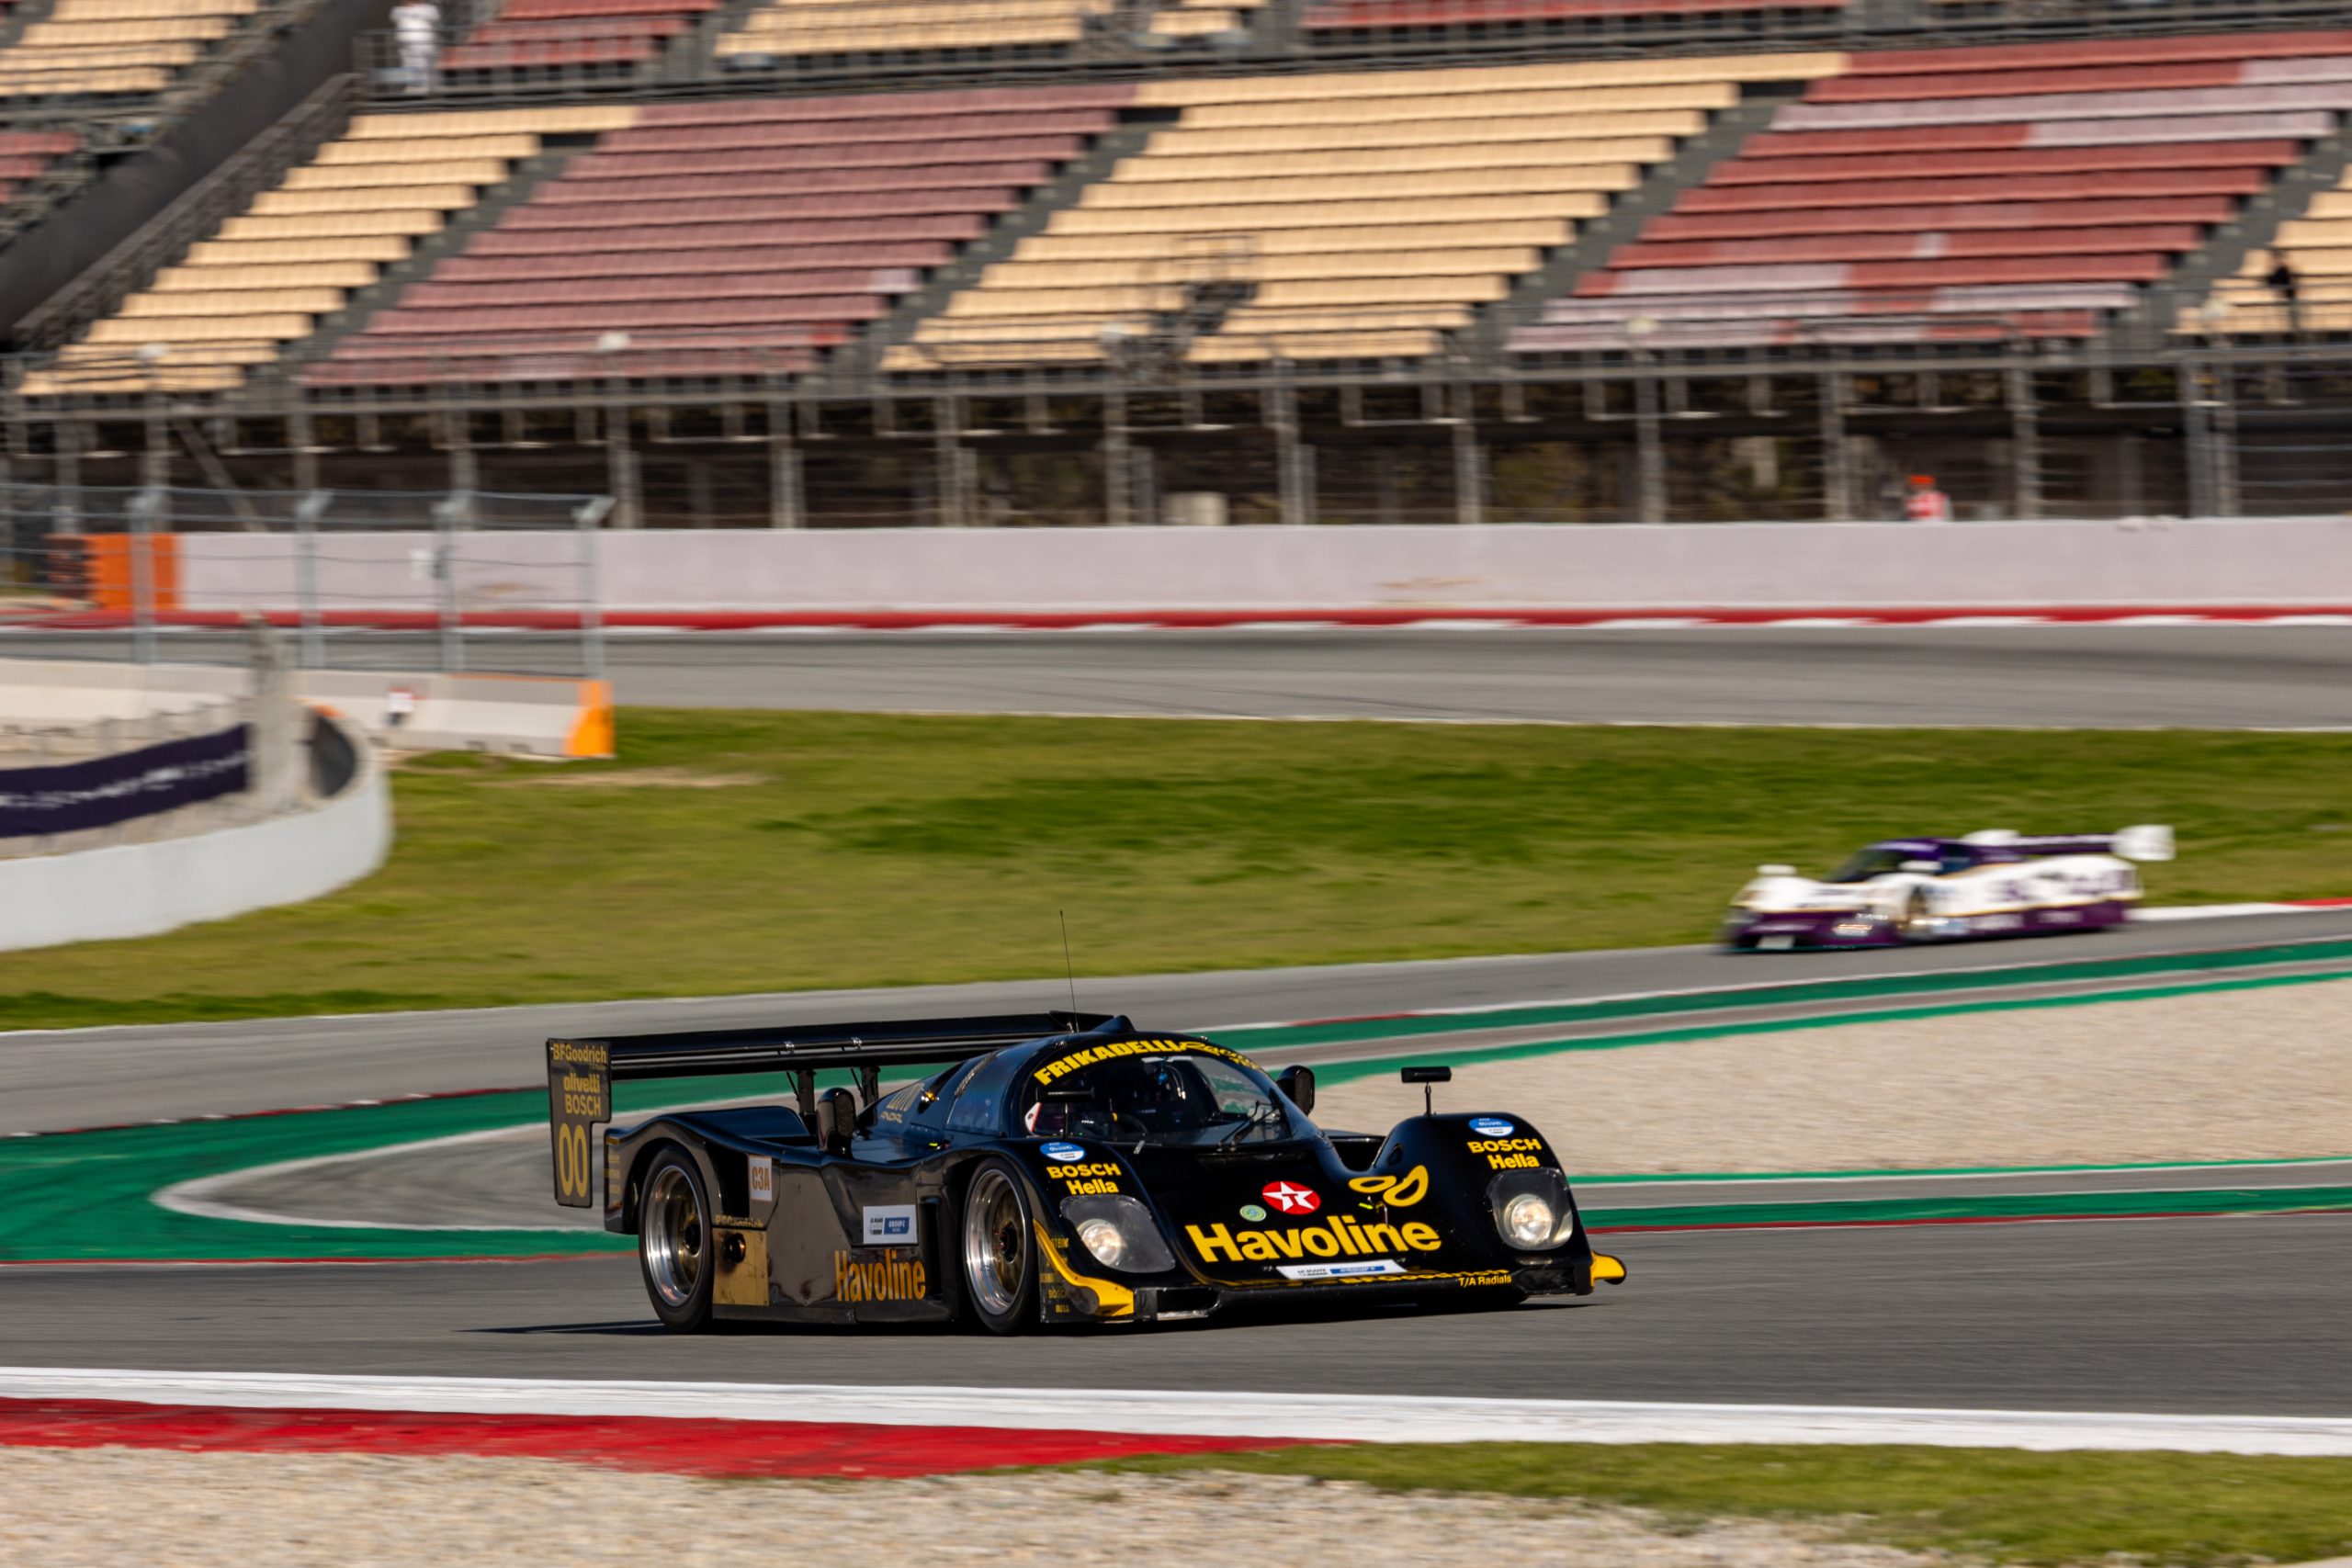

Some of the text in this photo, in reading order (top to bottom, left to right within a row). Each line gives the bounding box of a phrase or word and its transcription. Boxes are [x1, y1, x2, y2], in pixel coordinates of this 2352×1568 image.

[552, 1043, 607, 1063] BFGoodrich
[1034, 1040, 1182, 1086] FRIKADELLI
[563, 1072, 600, 1093] olivetti
[565, 1094, 602, 1116] BOSCH
[1467, 1138, 1543, 1153] BOSCH
[559, 1122, 588, 1198] 00
[1487, 1153, 1540, 1169] Hella
[1046, 1163, 1121, 1179] BOSCH
[1066, 1179, 1119, 1195] Hella
[1184, 1214, 1442, 1263] Havoline
[834, 1248, 926, 1302] Havoline
[1458, 1275, 1511, 1288] T/A Radials
